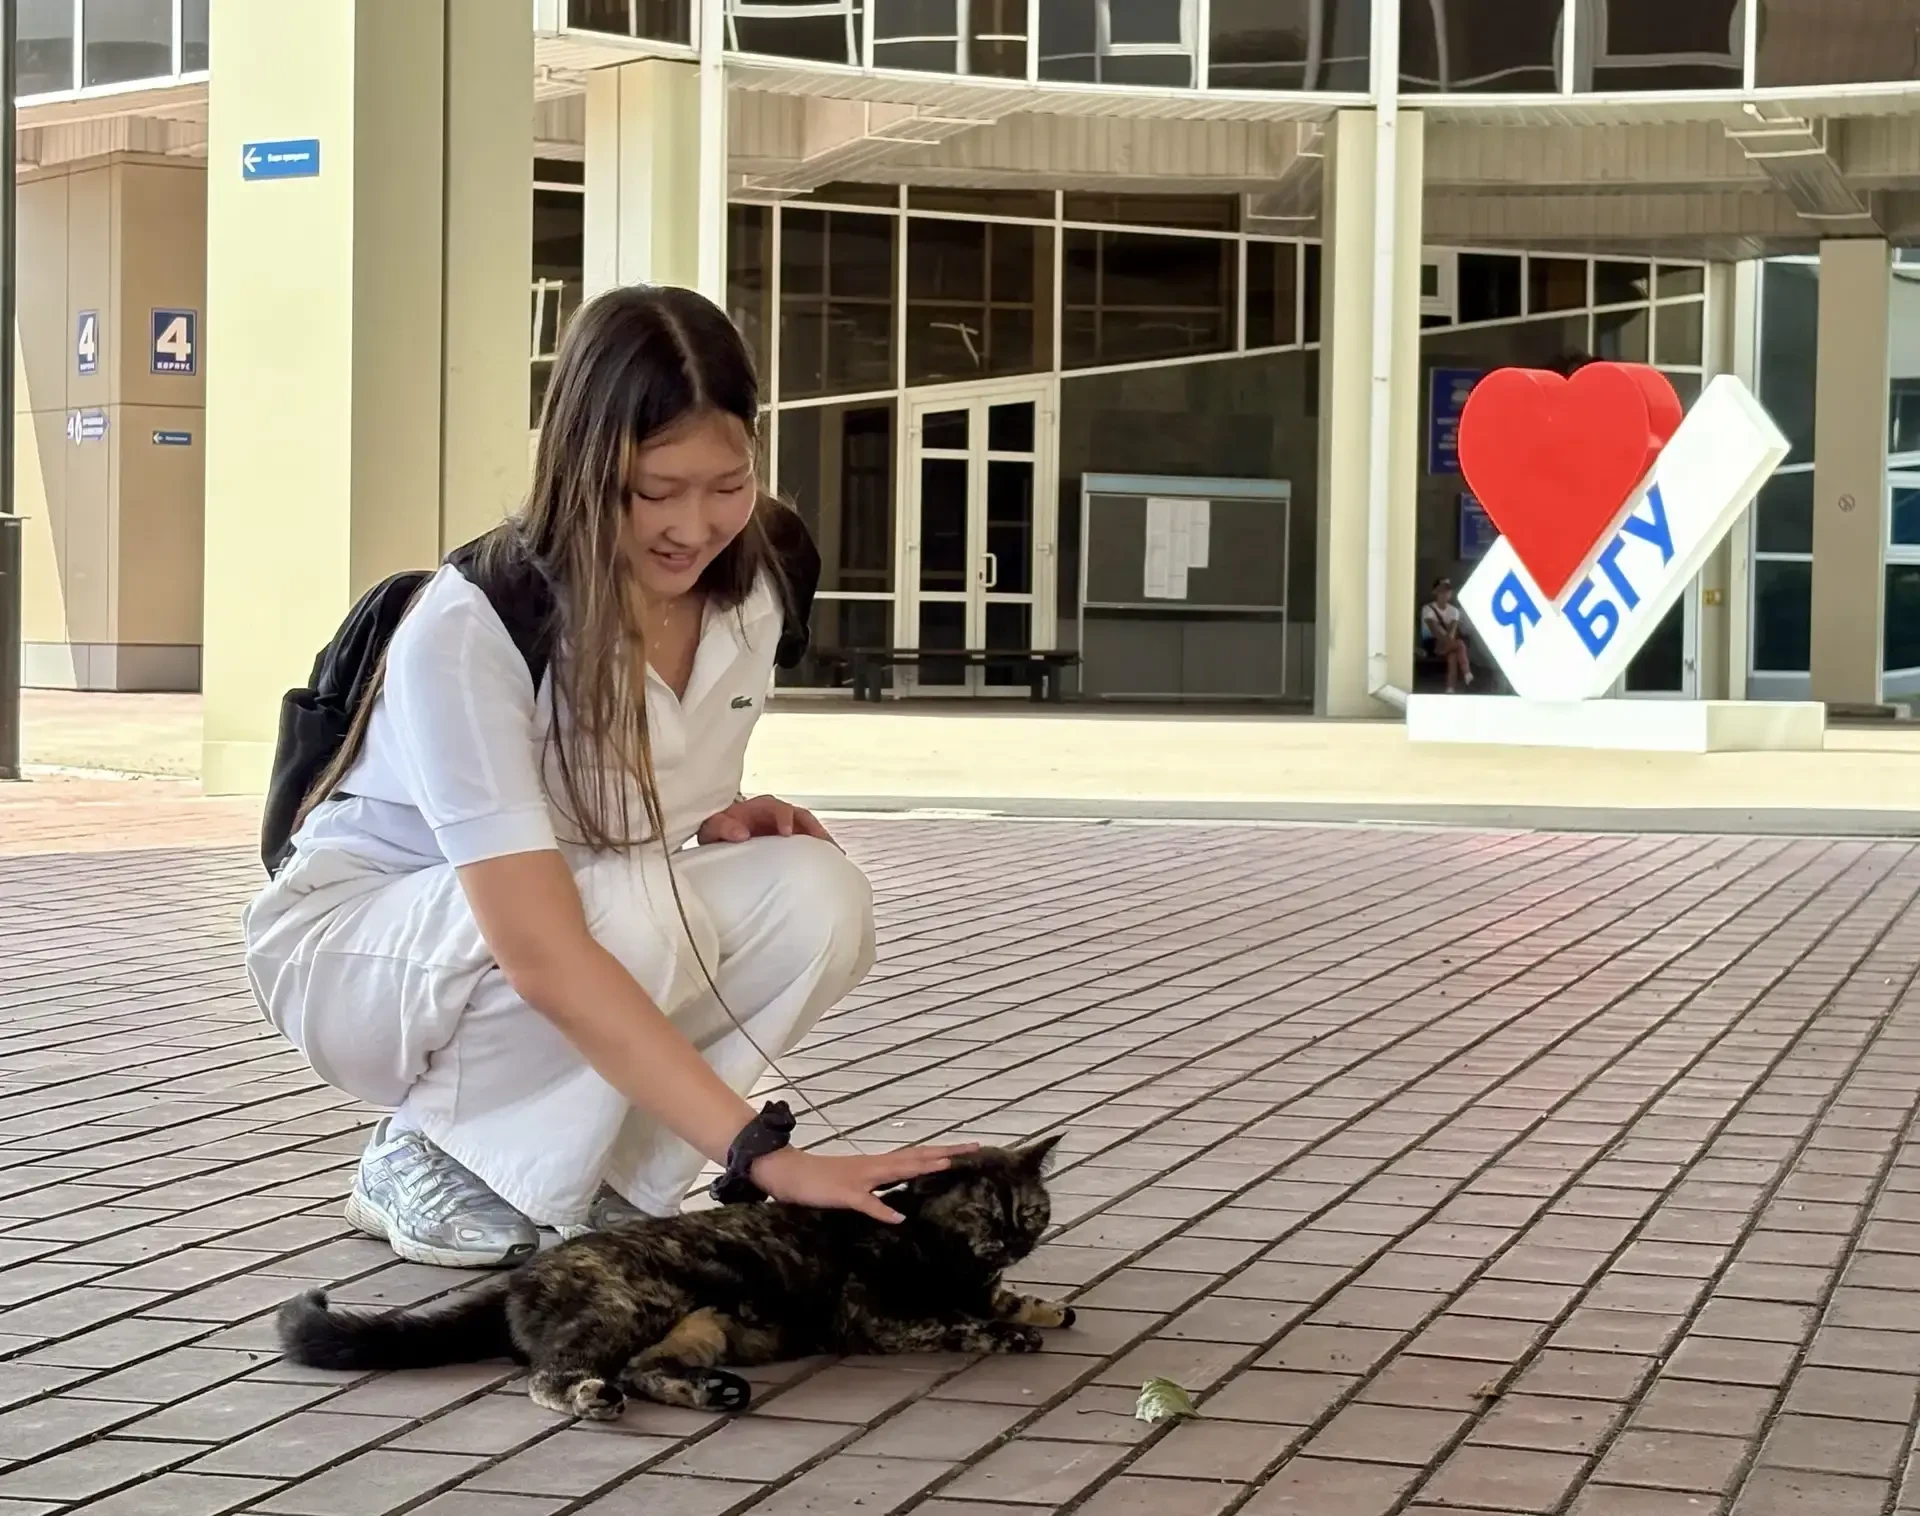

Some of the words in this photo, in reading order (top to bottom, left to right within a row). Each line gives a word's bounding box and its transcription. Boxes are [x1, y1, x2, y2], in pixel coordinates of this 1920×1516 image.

[79, 316, 95, 361] 4
[156, 316, 191, 361] 4
[1561, 480, 1675, 660] БГУ
[1491, 568, 1542, 655] Я
